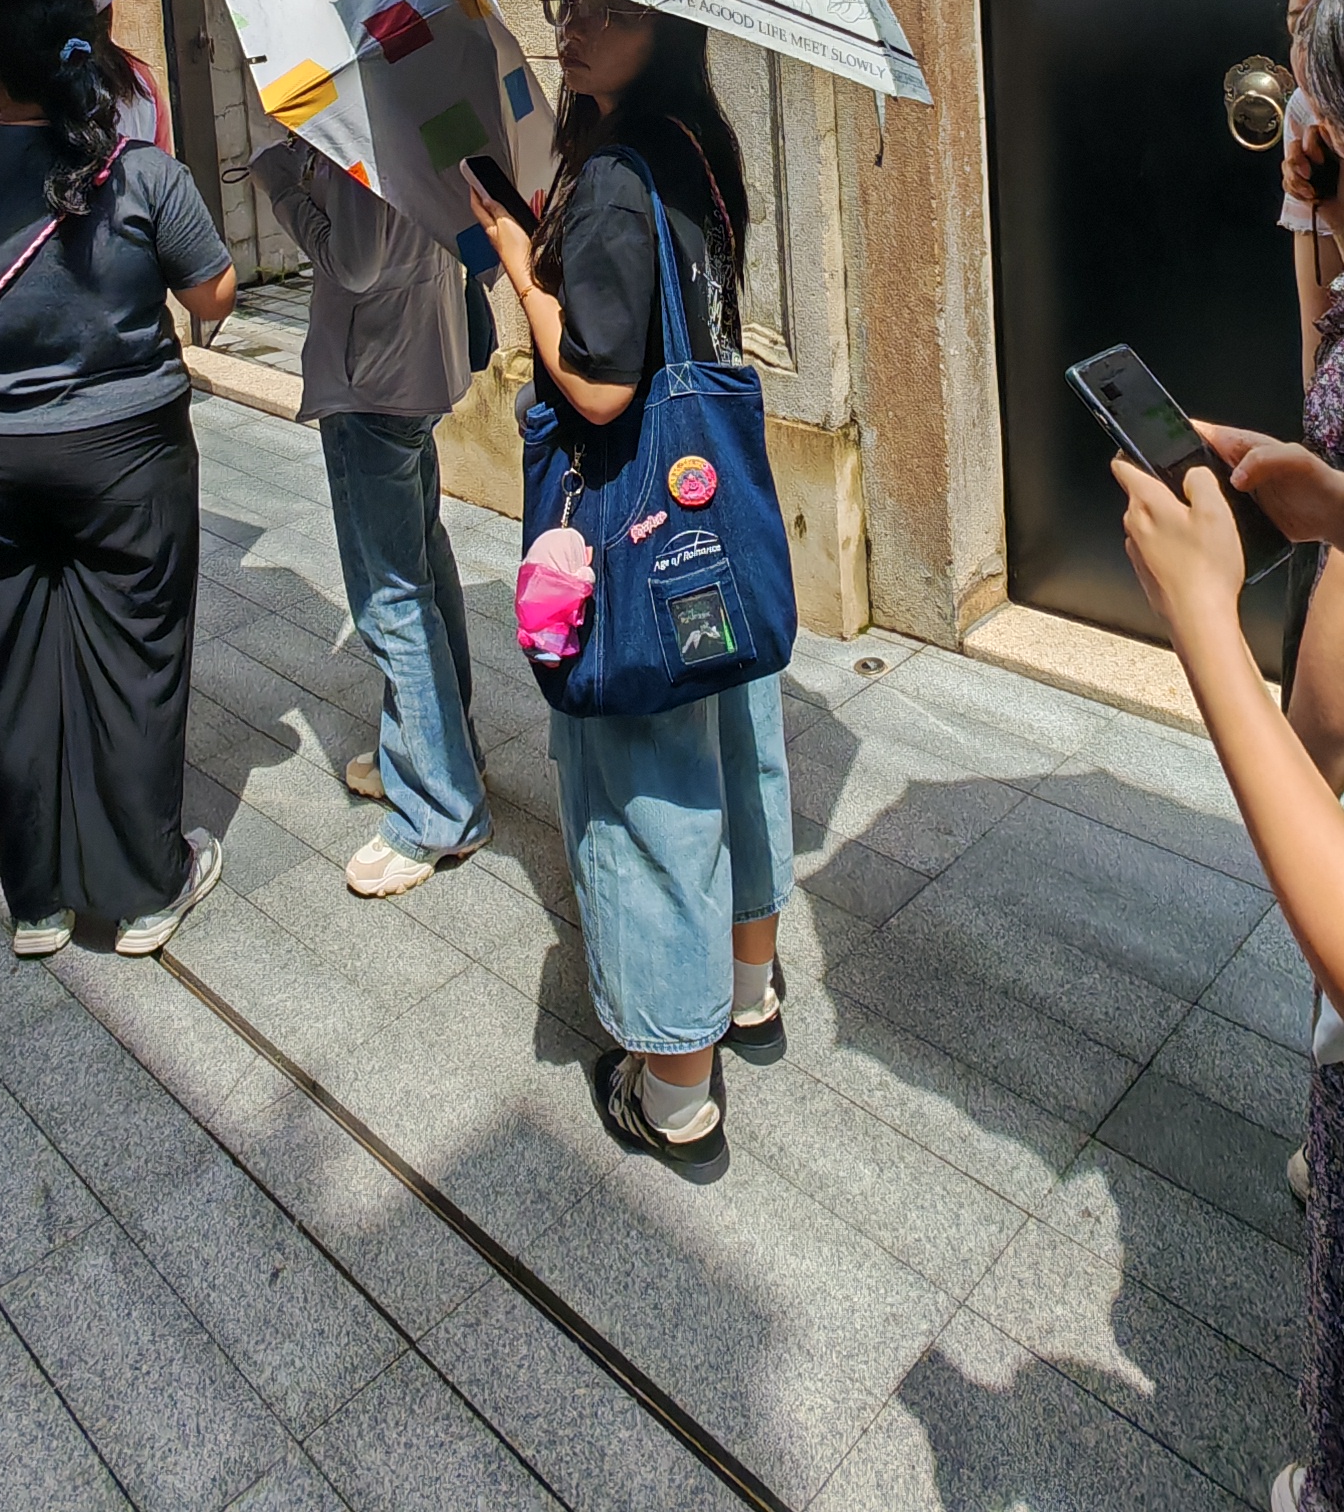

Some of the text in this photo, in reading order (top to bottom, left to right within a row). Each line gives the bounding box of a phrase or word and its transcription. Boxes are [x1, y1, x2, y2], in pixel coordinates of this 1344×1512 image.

[757, 20, 788, 43] LIFE
[791, 32, 830, 58] MEET
[831, 49, 887, 80] SLOWLY
[654, 544, 722, 572] Age of Romance
